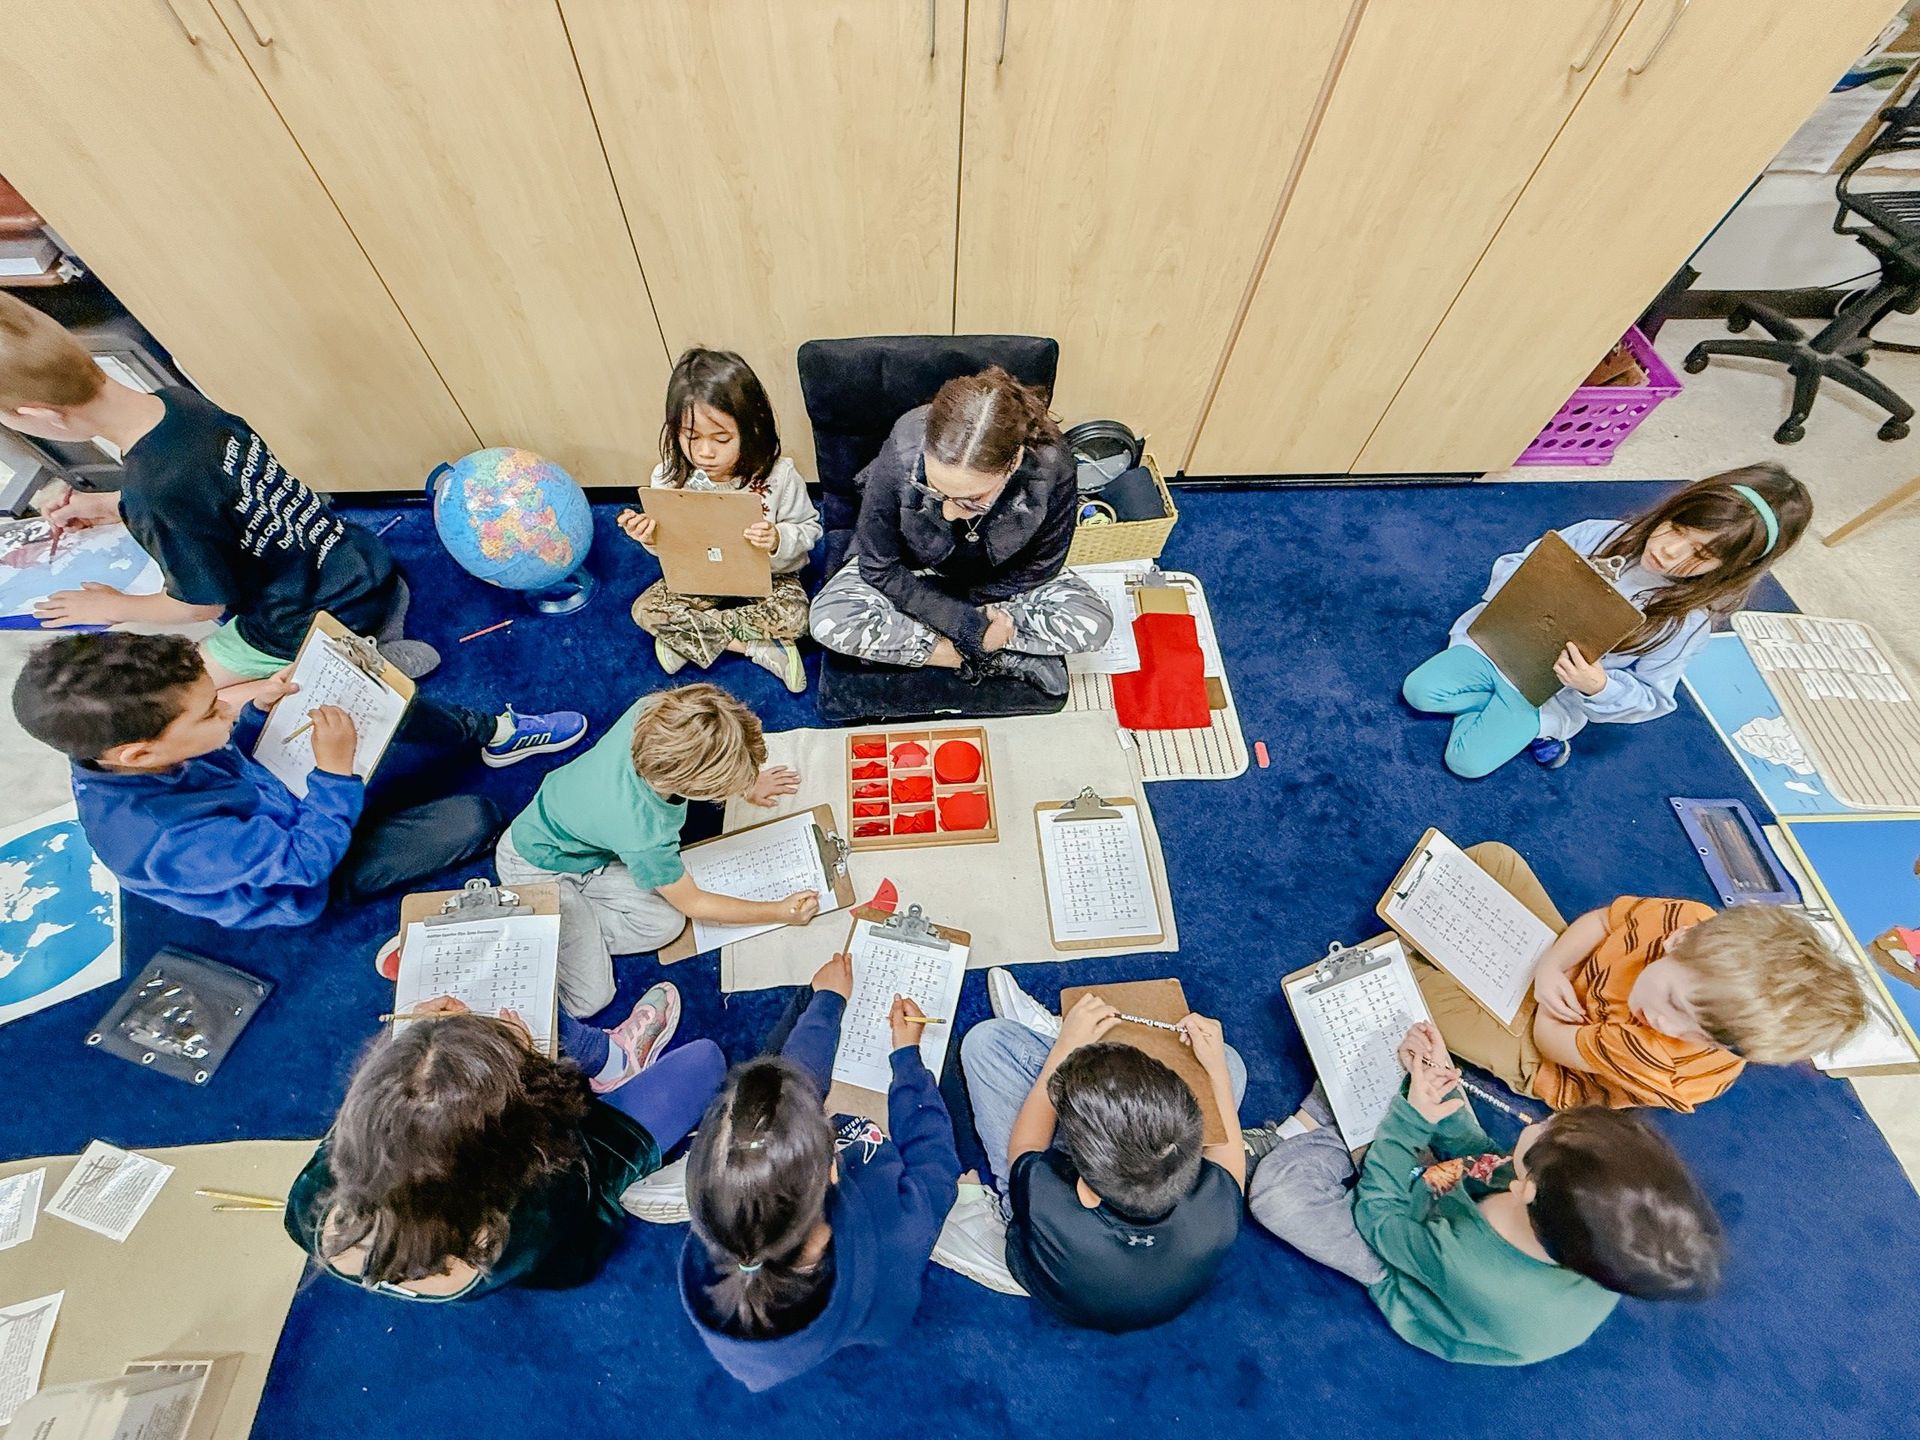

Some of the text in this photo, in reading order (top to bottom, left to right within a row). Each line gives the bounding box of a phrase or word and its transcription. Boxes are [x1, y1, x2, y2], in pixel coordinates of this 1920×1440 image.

[222, 435, 241, 476] BATTERY
[242, 461, 256, 478] OF
[235, 475, 254, 514] MASER
[282, 474, 295, 492] (SA
[296, 481, 309, 501] HE
[308, 516, 330, 545] ORION
